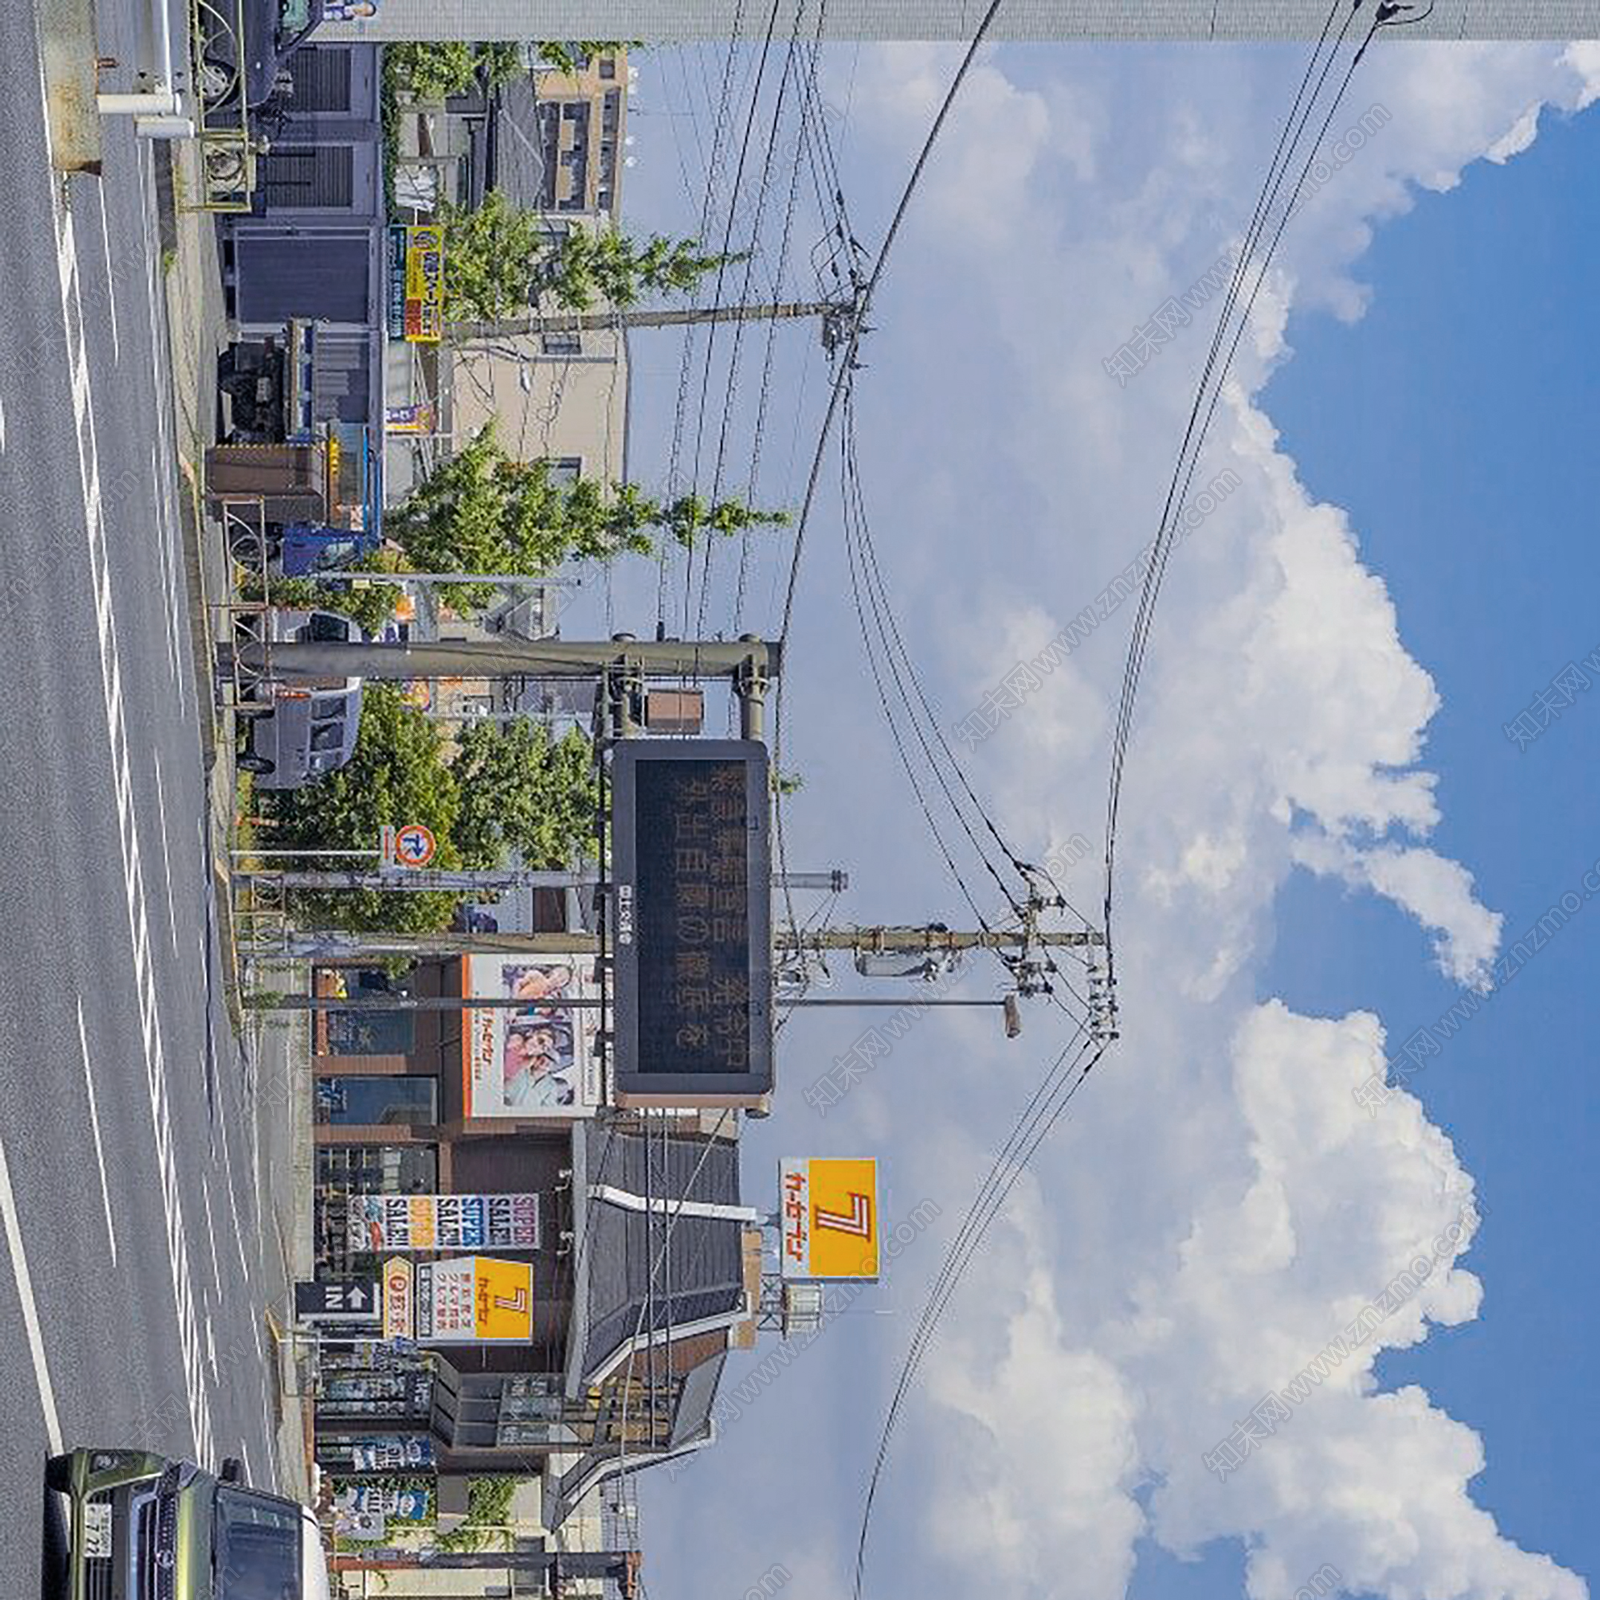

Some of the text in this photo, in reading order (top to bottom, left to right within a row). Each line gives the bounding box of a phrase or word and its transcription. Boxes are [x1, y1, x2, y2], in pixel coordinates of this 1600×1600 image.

[385, 1198, 408, 1247] SALE!!
[461, 1197, 485, 1247] SUPER
[512, 1196, 535, 1246] SUPER
[325, 1286, 343, 1310] IN
